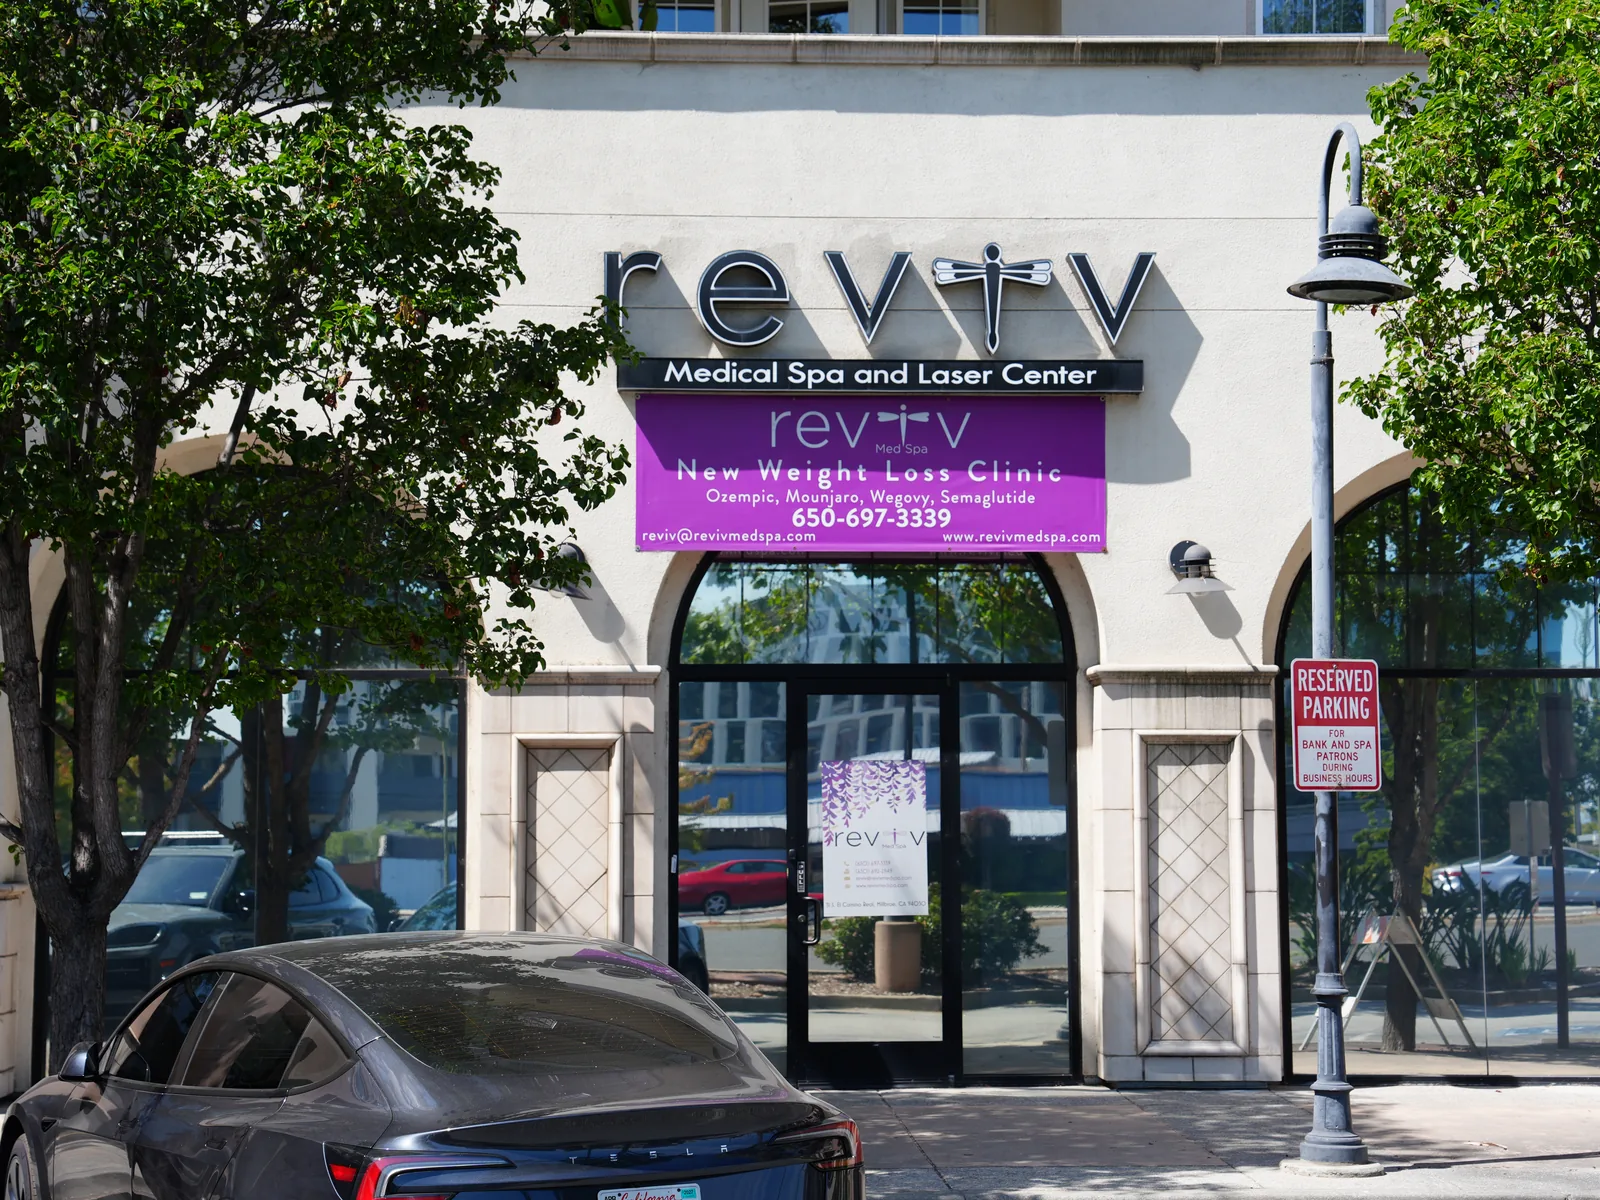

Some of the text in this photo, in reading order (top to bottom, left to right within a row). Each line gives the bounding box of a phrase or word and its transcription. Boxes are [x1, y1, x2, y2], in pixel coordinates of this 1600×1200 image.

[664, 360, 1097, 389] Medical Spa and Laser Center
[875, 444, 928, 455] Med Spa
[677, 458, 1061, 490] New Weight Loss Clinic
[706, 488, 1036, 508] Ozempic, Mounjaro, Wegovy, Semaglutide
[792, 507, 952, 528] 650-697-3339
[642, 528, 816, 546] reviv@revivmedspa.com
[942, 530, 1101, 547] www.revivmedspa.com
[1298, 668, 1373, 692] RESERVED
[1303, 696, 1370, 720] PARKING
[1328, 729, 1345, 738] FOR
[1302, 740, 1372, 749] BANK AND SPA
[1316, 751, 1359, 761] PATRONS
[1322, 763, 1353, 772] DURING
[1303, 774, 1373, 783] BUSINESS HOURS
[569, 1144, 728, 1165] TESLA
